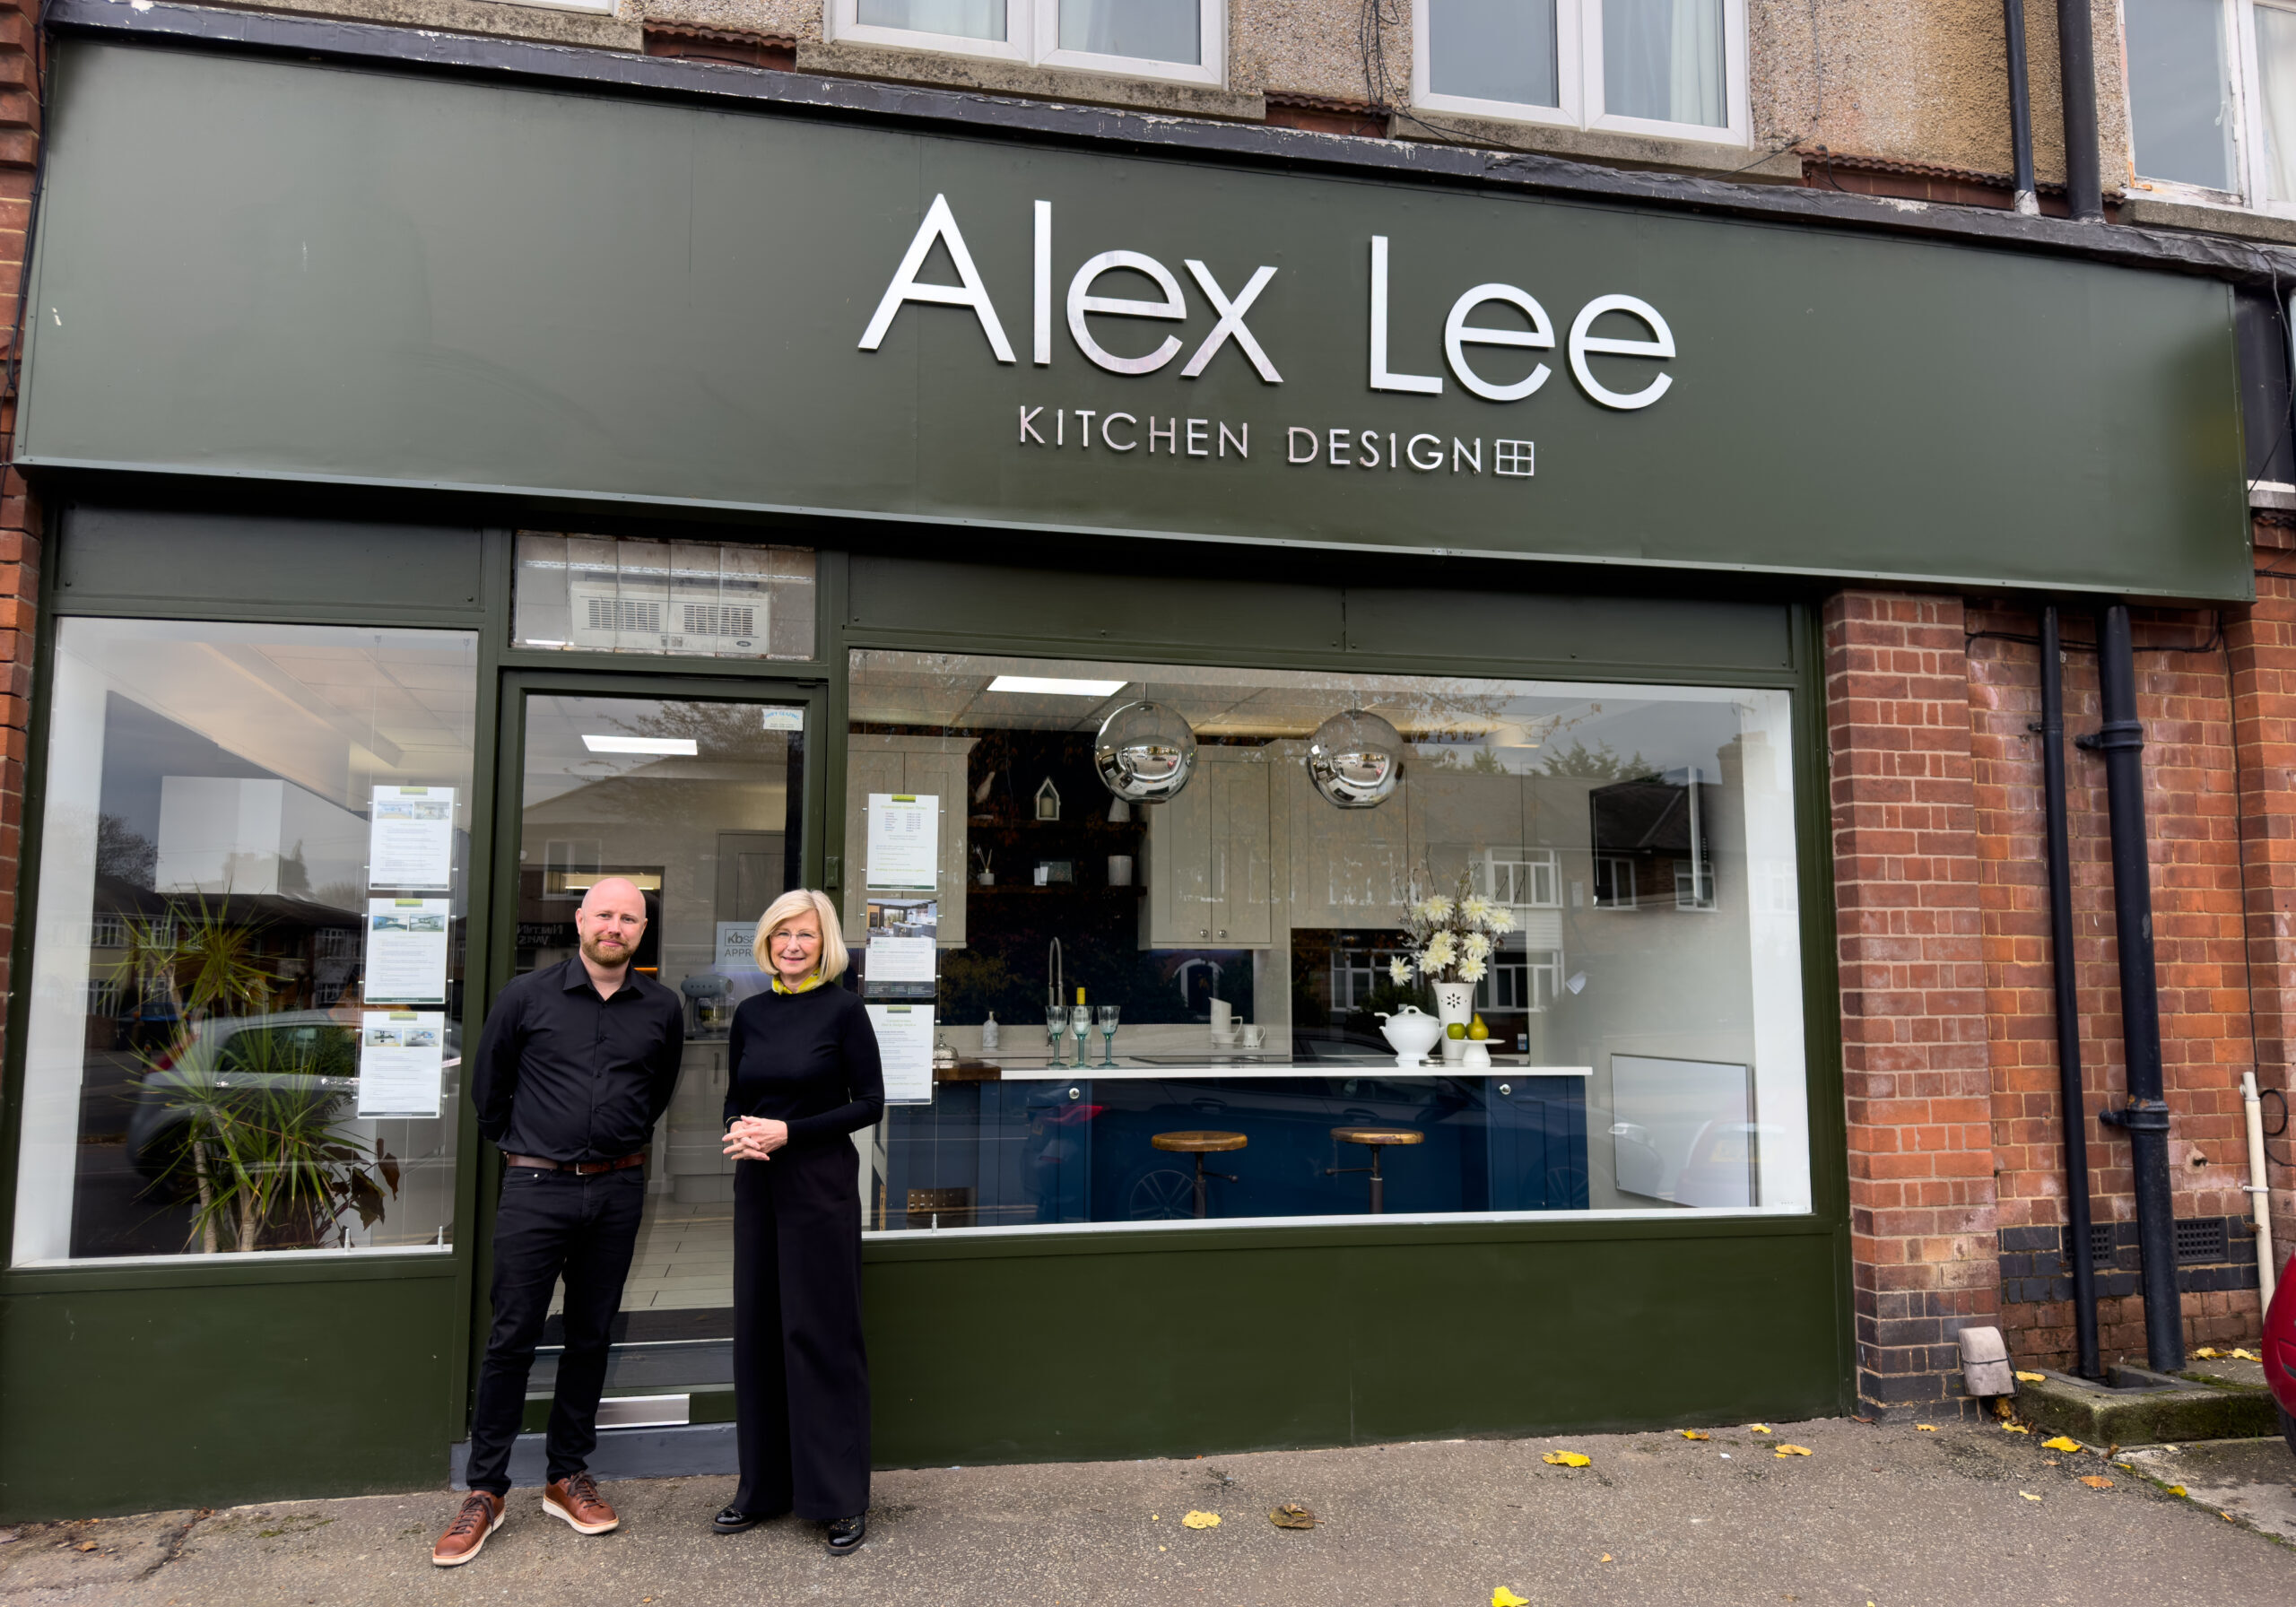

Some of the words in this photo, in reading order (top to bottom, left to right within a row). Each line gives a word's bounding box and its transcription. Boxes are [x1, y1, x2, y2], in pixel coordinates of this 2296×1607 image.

[857, 193, 1283, 383] Alex
[1370, 235, 1676, 410] Lee
[1019, 406, 1248, 458] KITCHEN
[1288, 427, 1482, 473] DESIGN
[725, 948, 754, 958] APPR
